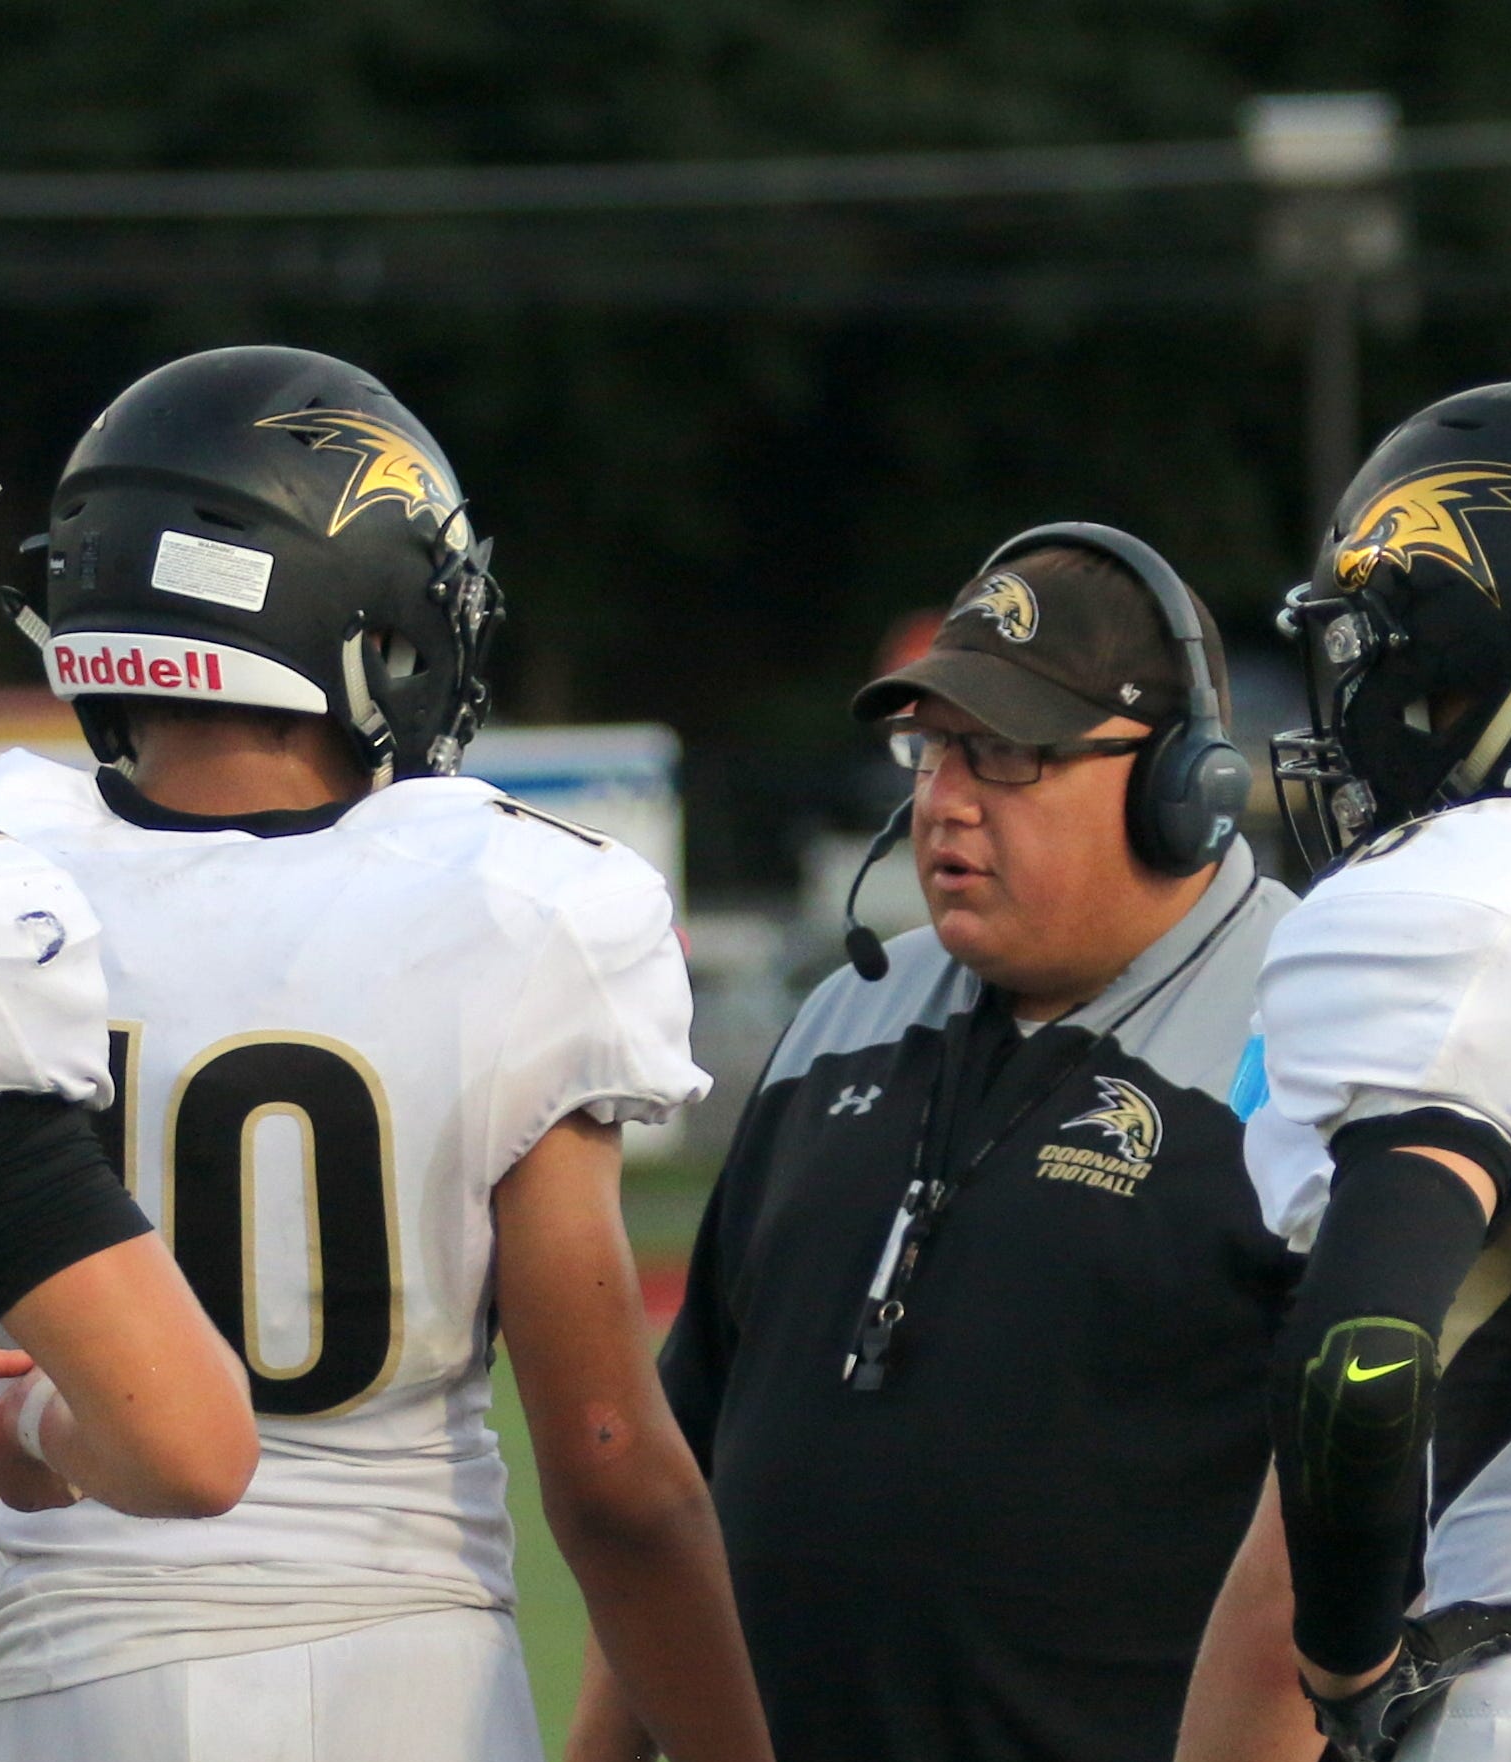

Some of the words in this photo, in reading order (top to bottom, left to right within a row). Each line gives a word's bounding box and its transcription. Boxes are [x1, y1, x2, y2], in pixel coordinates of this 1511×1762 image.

[55, 645, 222, 691] Riddell
[1035, 1162, 1136, 1197] FOOTBALL
[1037, 1144, 1153, 1180] CORNING
[106, 1019, 404, 1420] 0
